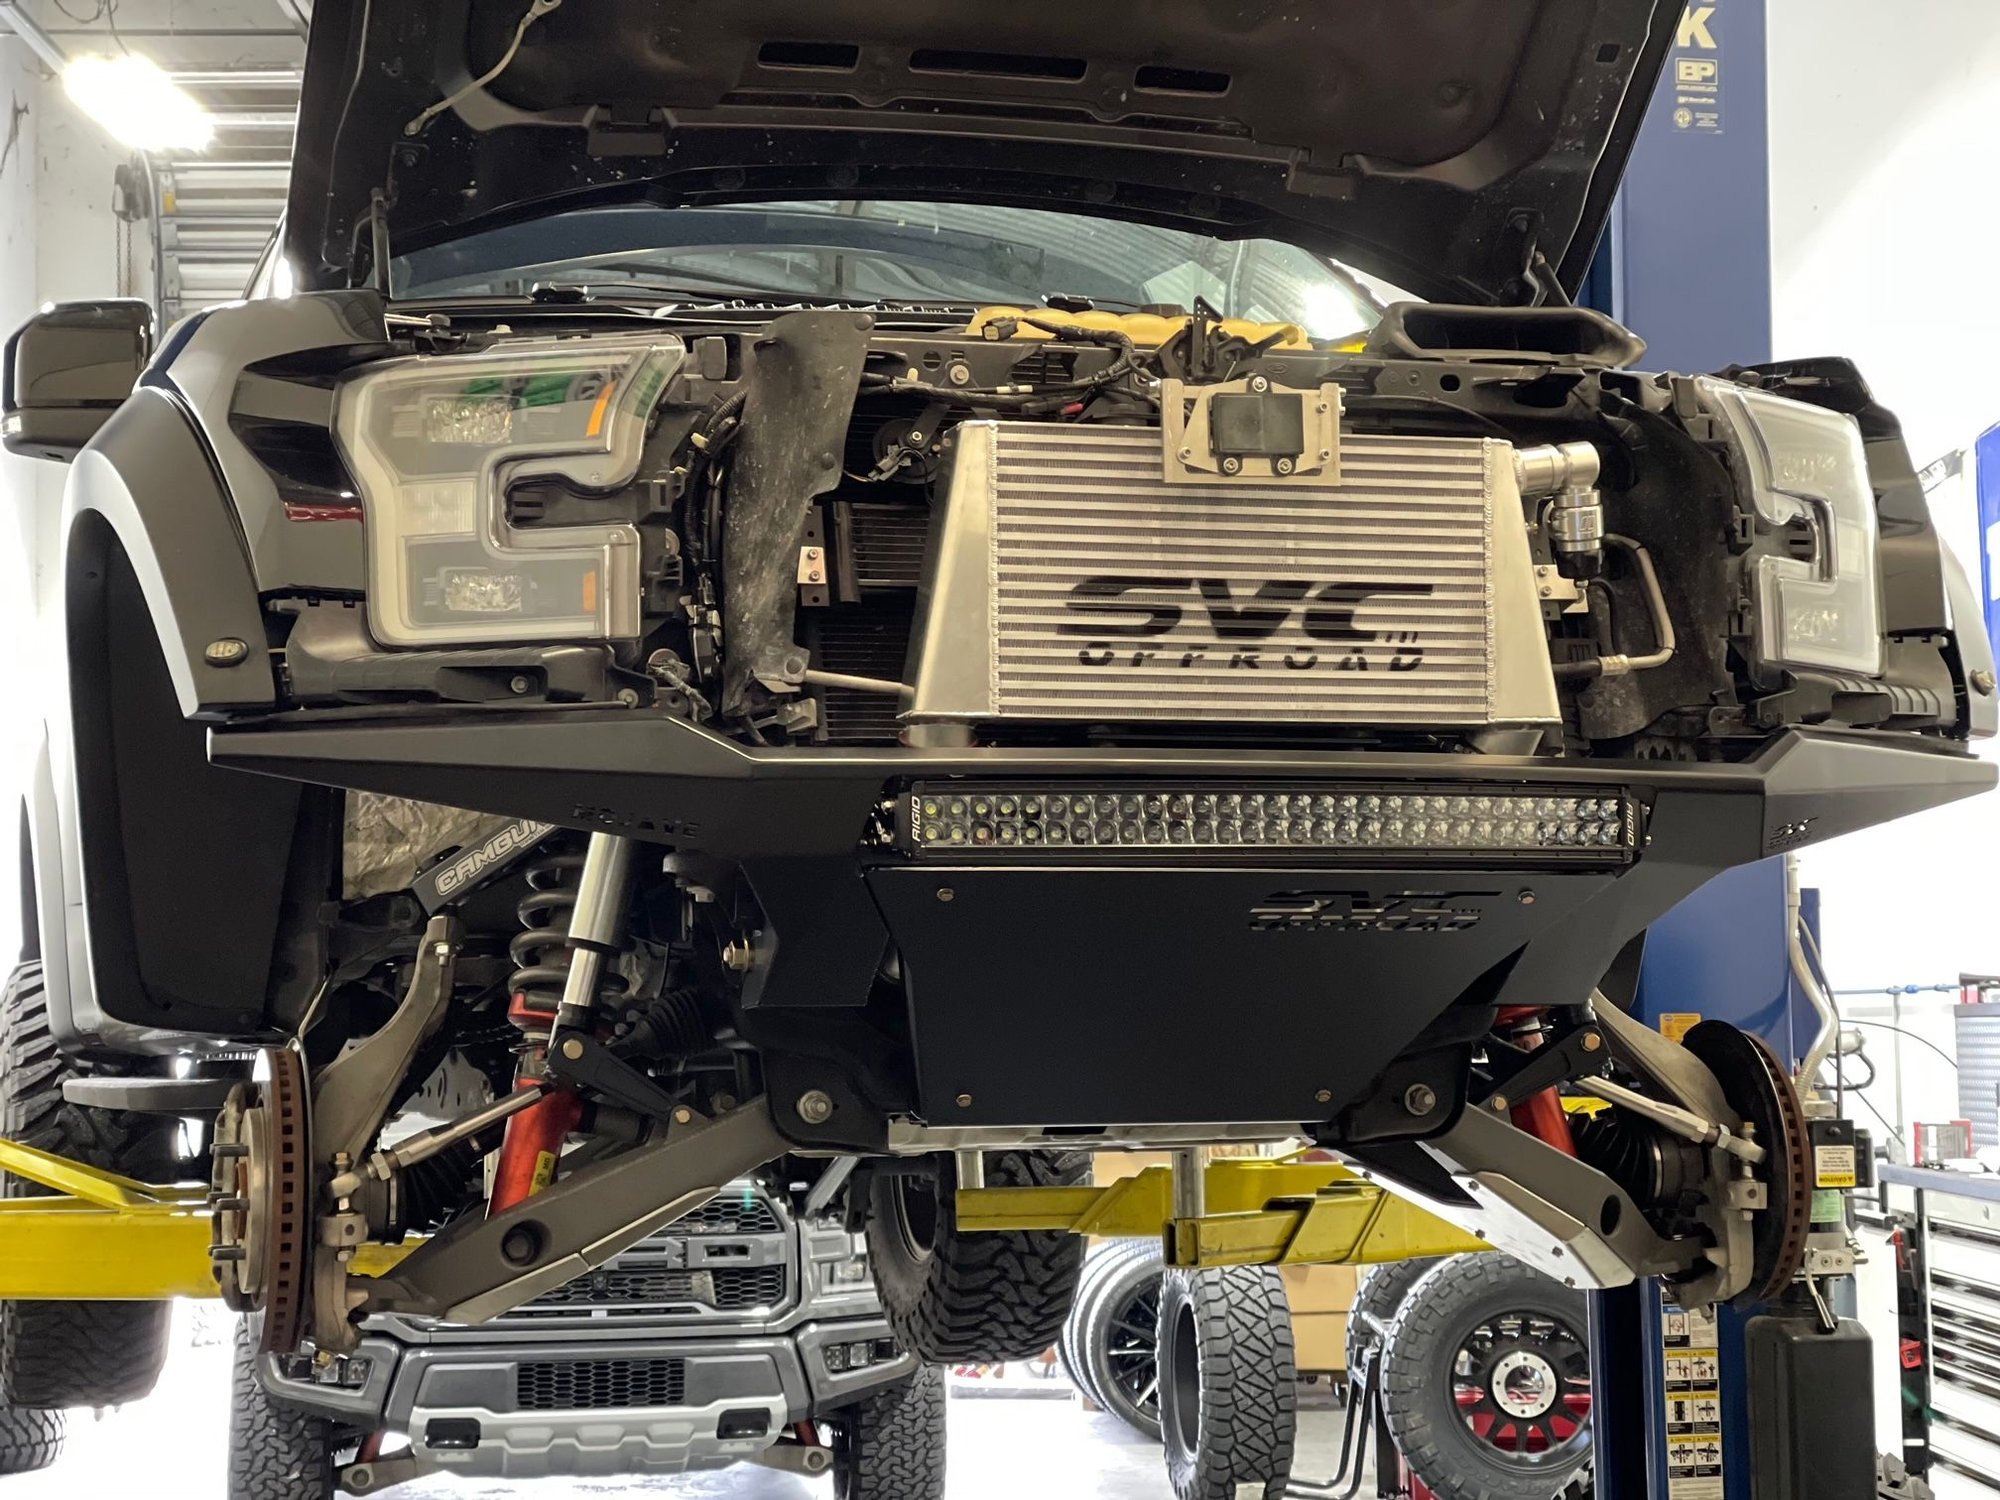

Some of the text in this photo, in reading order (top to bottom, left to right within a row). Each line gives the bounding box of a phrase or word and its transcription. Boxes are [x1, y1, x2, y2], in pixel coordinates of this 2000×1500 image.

[1677, 6, 1718, 49] K
[1679, 61, 1715, 81] BP
[1056, 575, 1433, 641] SVC
[911, 795, 921, 842] RIGID
[1626, 802, 1635, 847] RIGID
